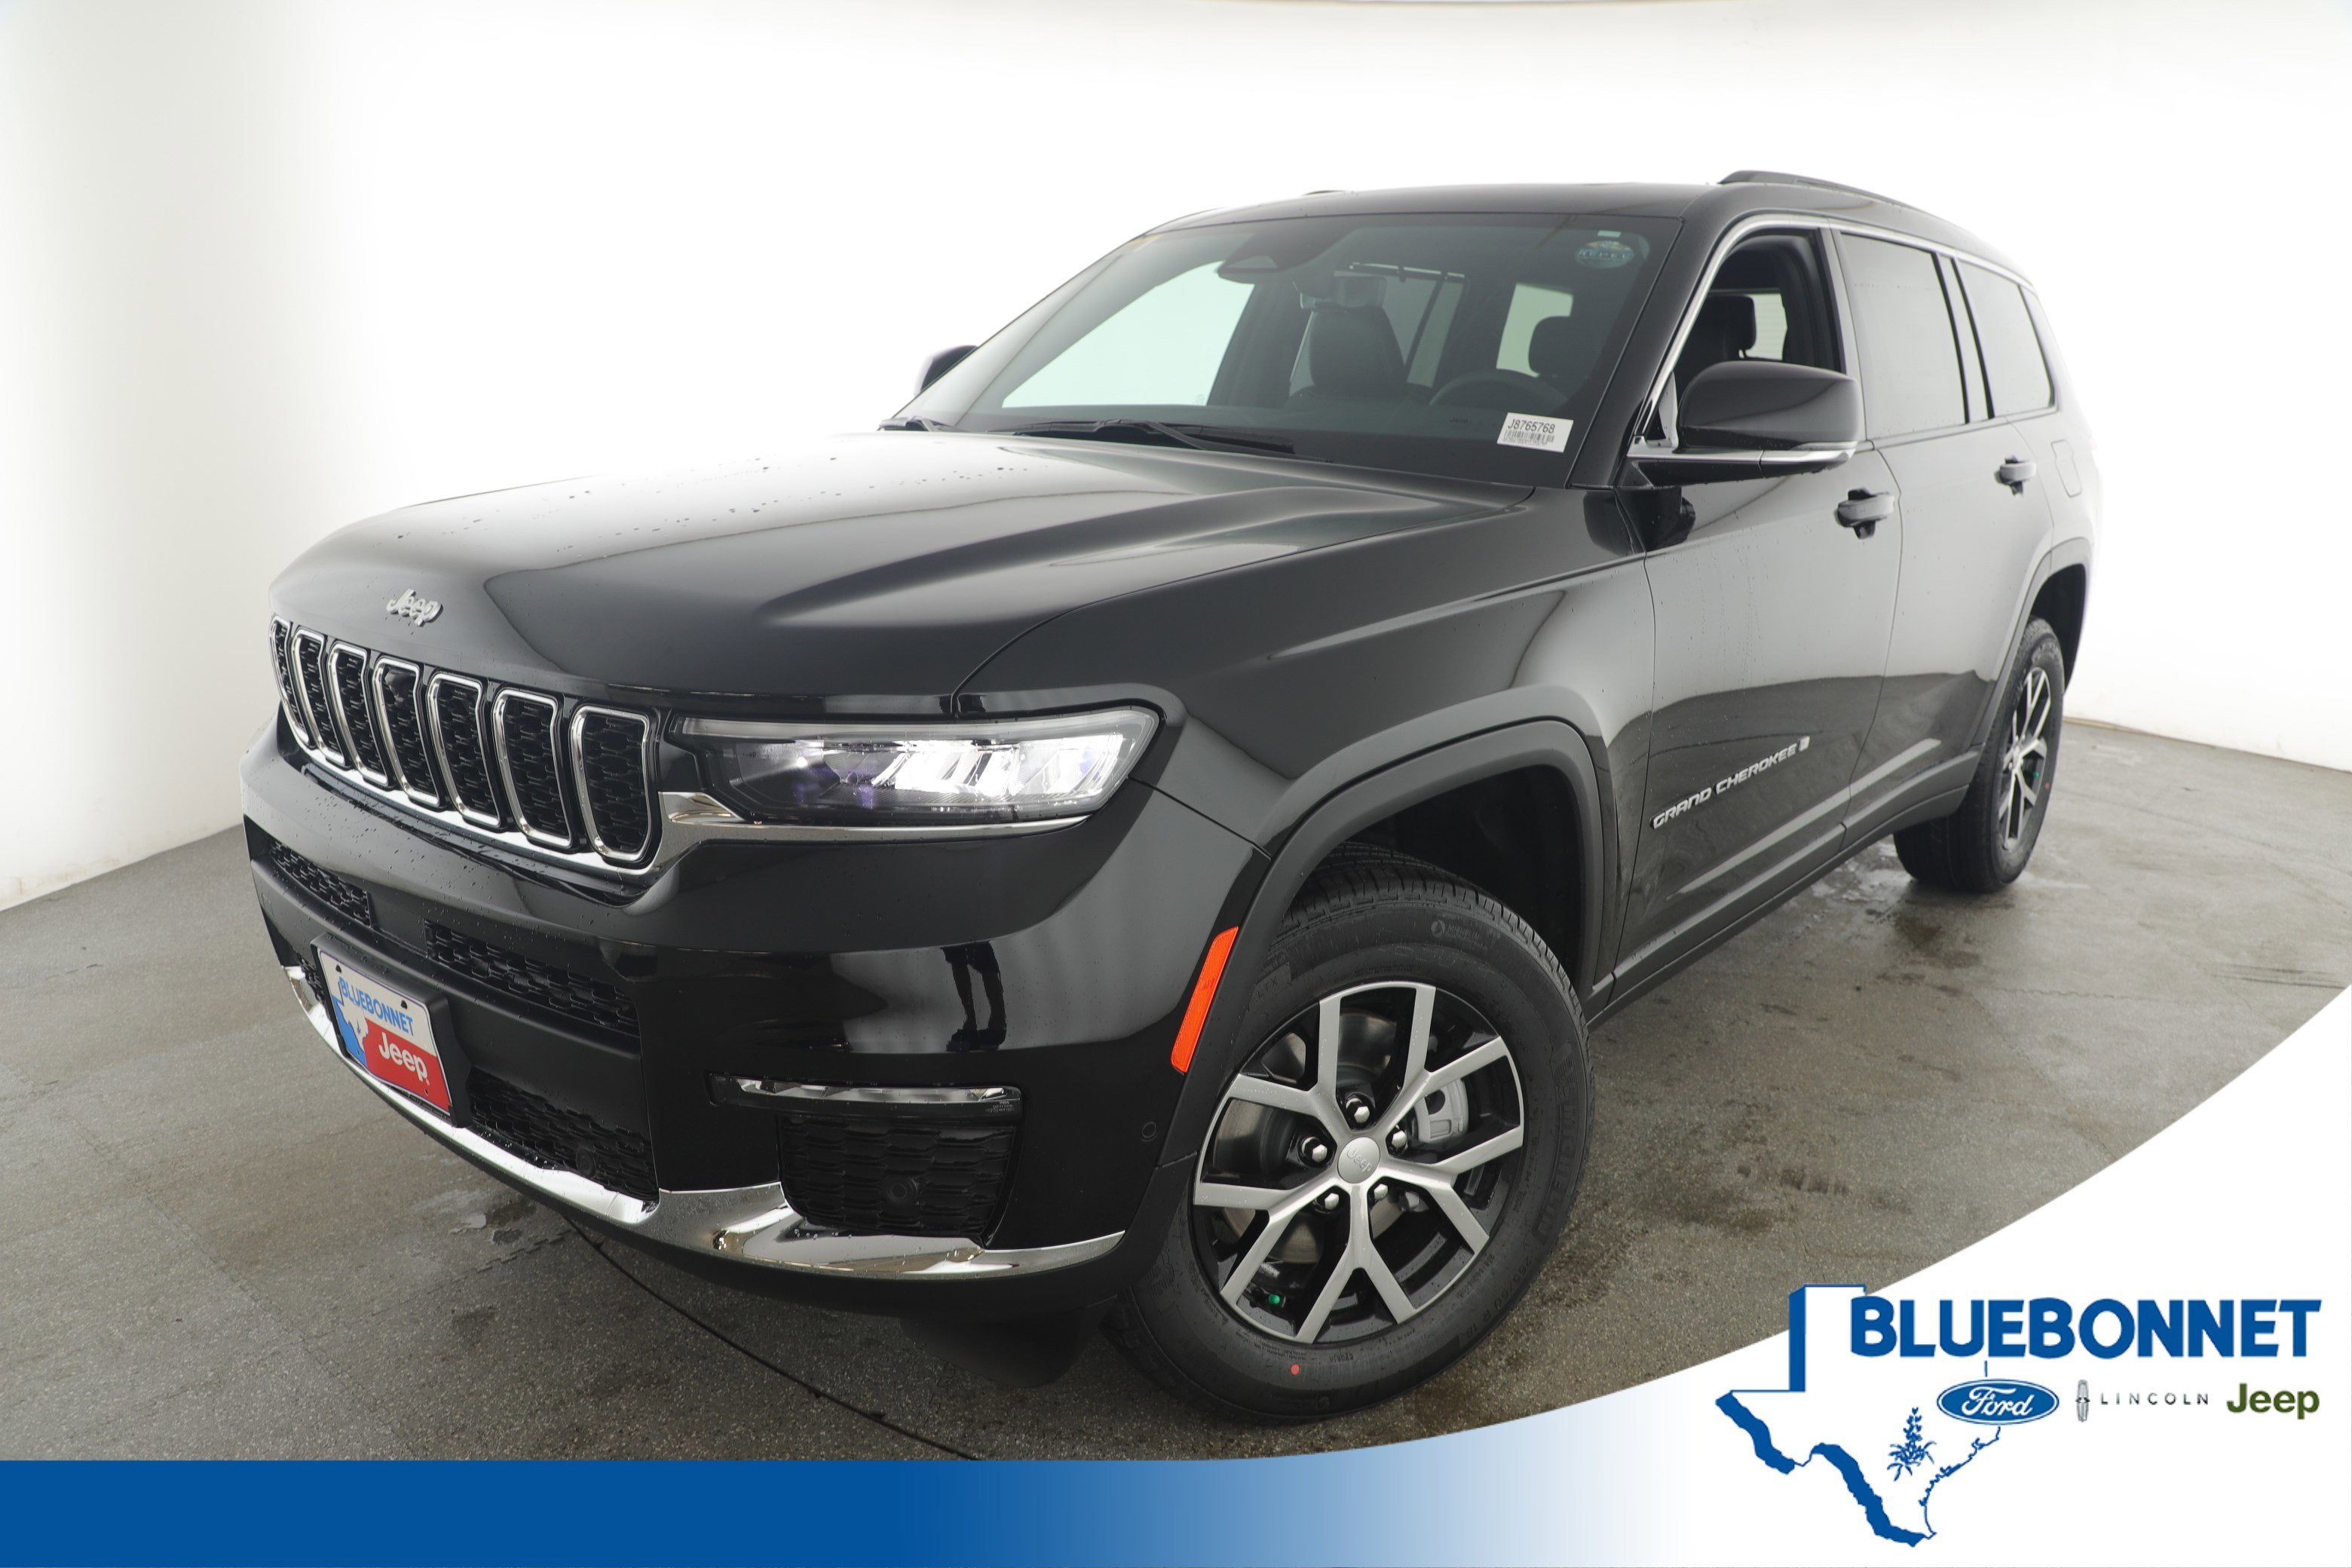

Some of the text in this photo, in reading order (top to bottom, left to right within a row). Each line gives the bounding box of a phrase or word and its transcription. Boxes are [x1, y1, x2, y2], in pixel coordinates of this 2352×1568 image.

[1508, 418, 1555, 433] J8765768
[386, 589, 440, 626] Jeep
[1652, 743, 1797, 829] GRAND CHEROKEE
[338, 976, 414, 1037] BLUEBONNET
[378, 1031, 428, 1082] Jeep
